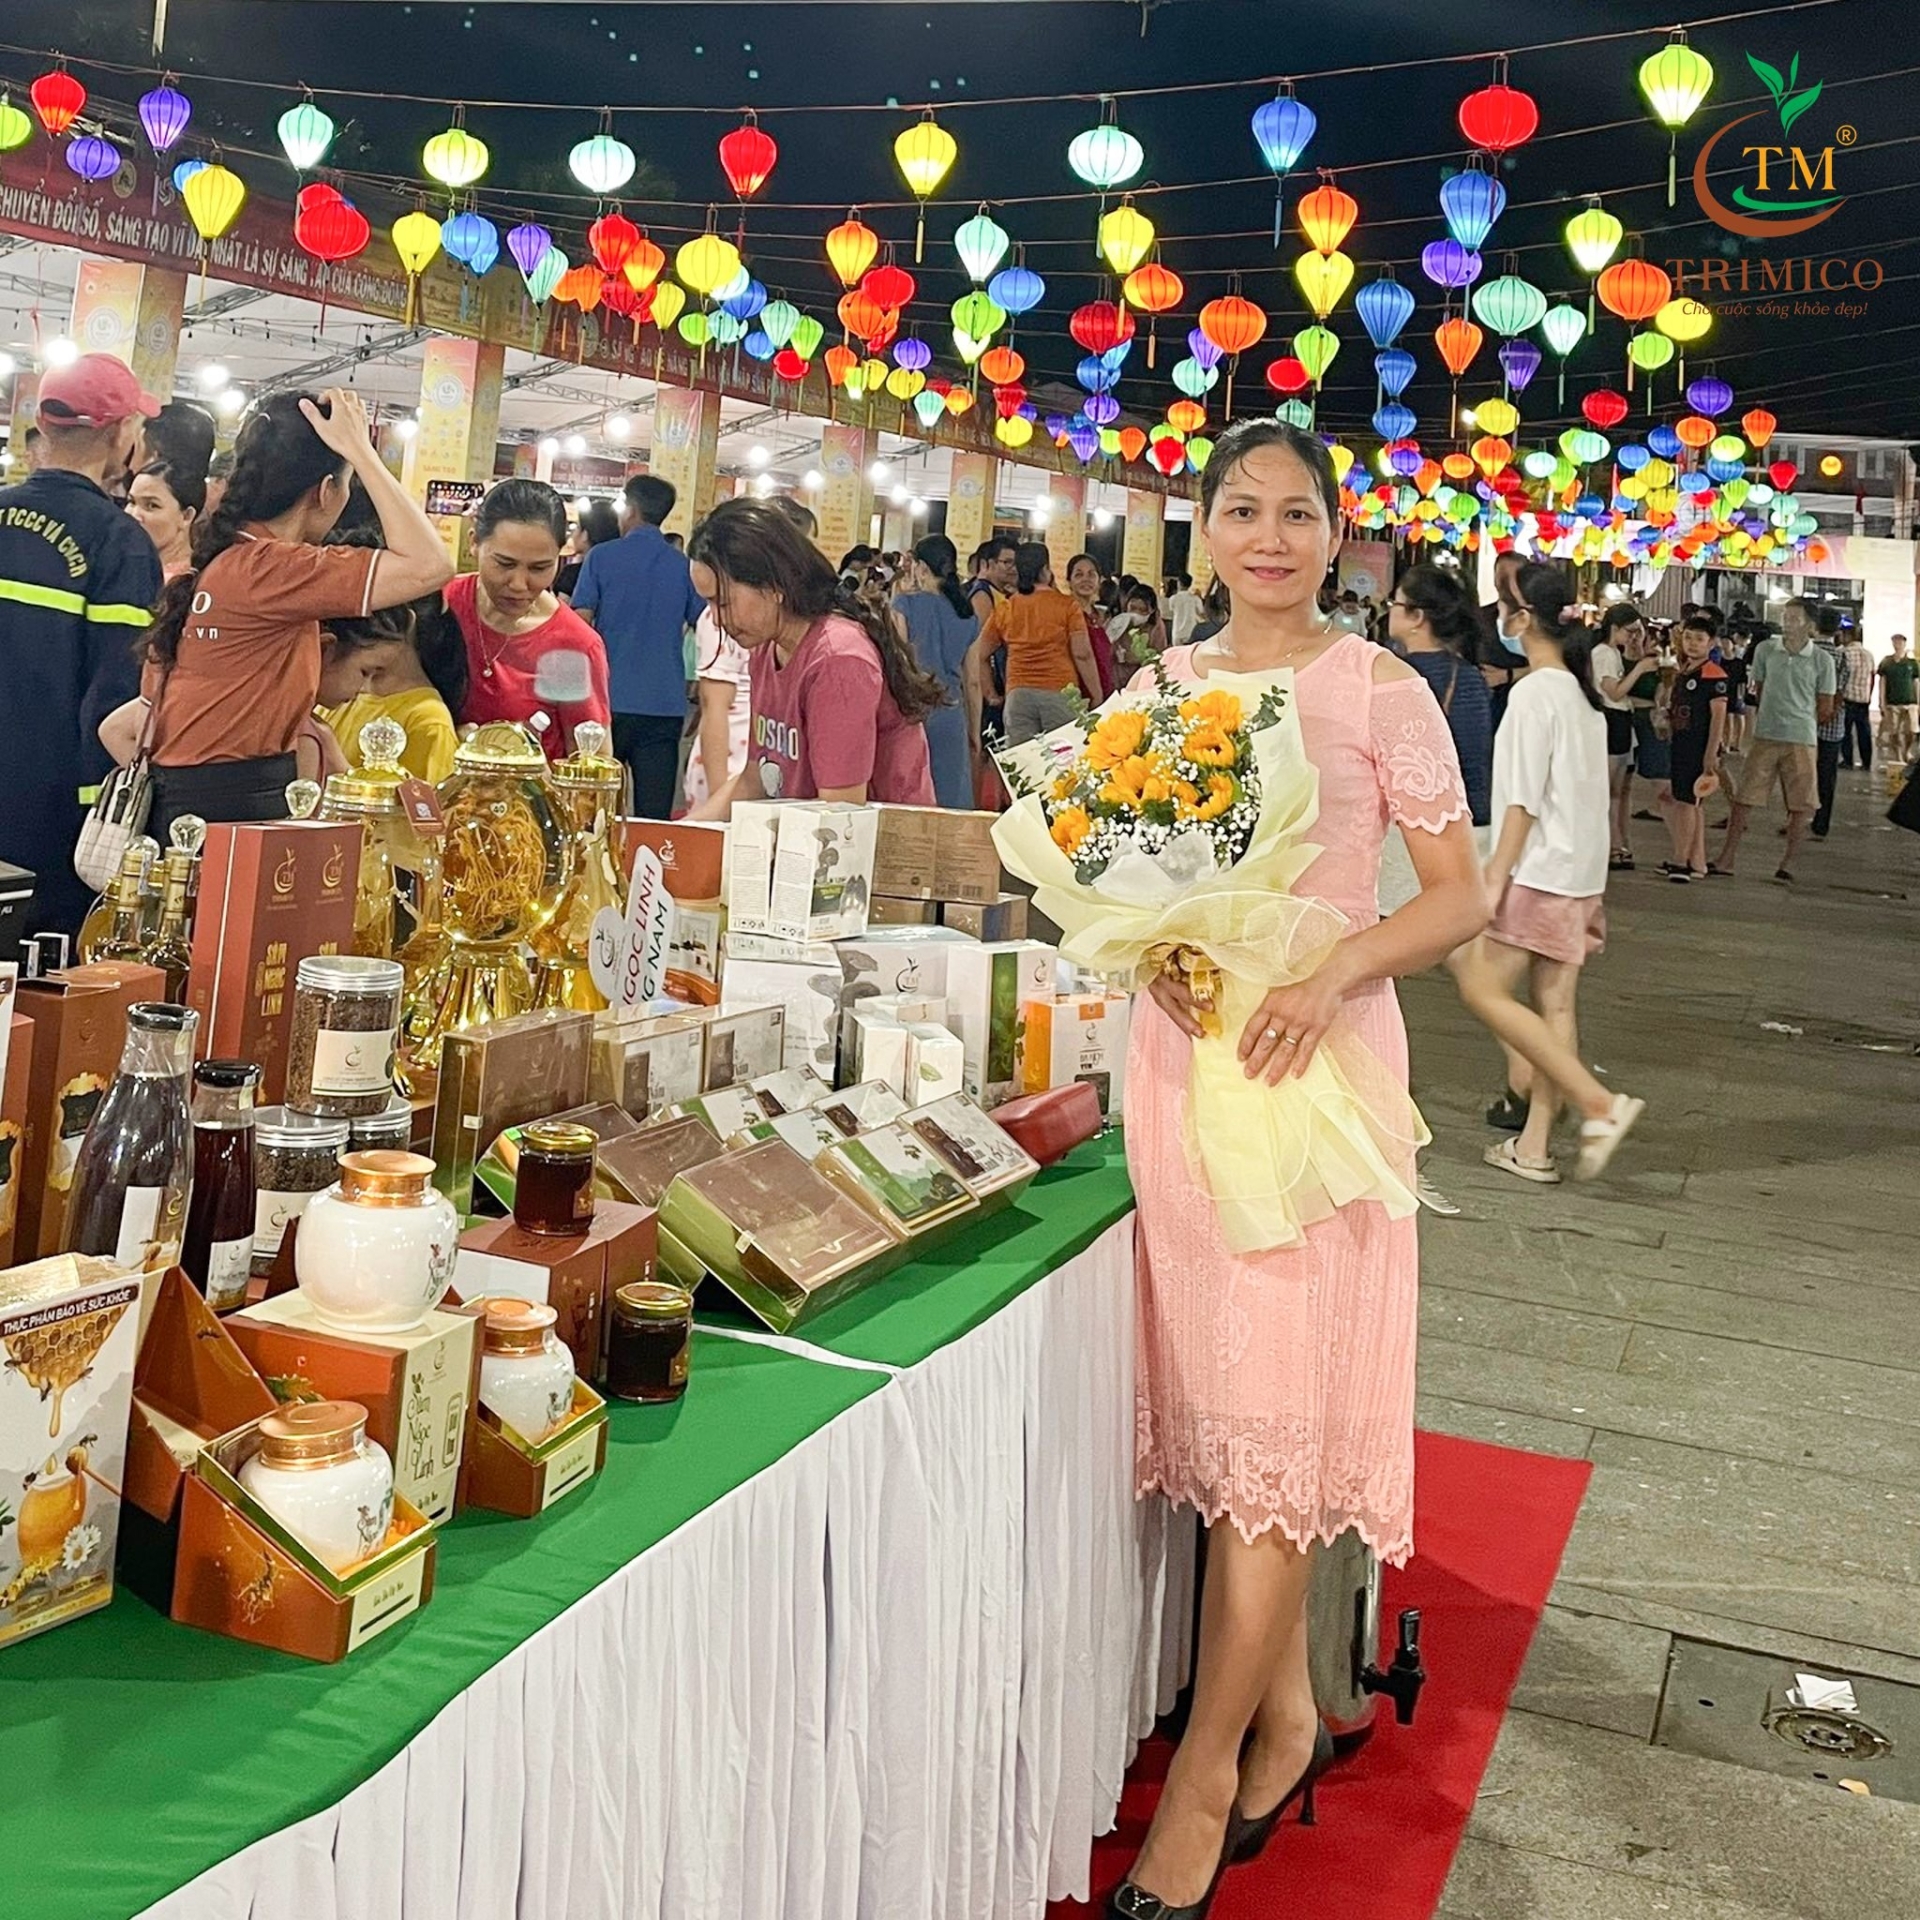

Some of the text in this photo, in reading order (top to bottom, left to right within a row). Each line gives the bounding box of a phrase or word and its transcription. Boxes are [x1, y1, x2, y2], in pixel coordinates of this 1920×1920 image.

[105, 206, 141, 246] SÁNG
[145, 219, 169, 257] TẠO
[243, 239, 258, 273] LÀ
[261, 247, 280, 283] SỰ
[280, 249, 309, 287] SÁNG
[6, 506, 46, 532] PCCC
[635, 864, 656, 932] LINH
[647, 900, 668, 970] NAM
